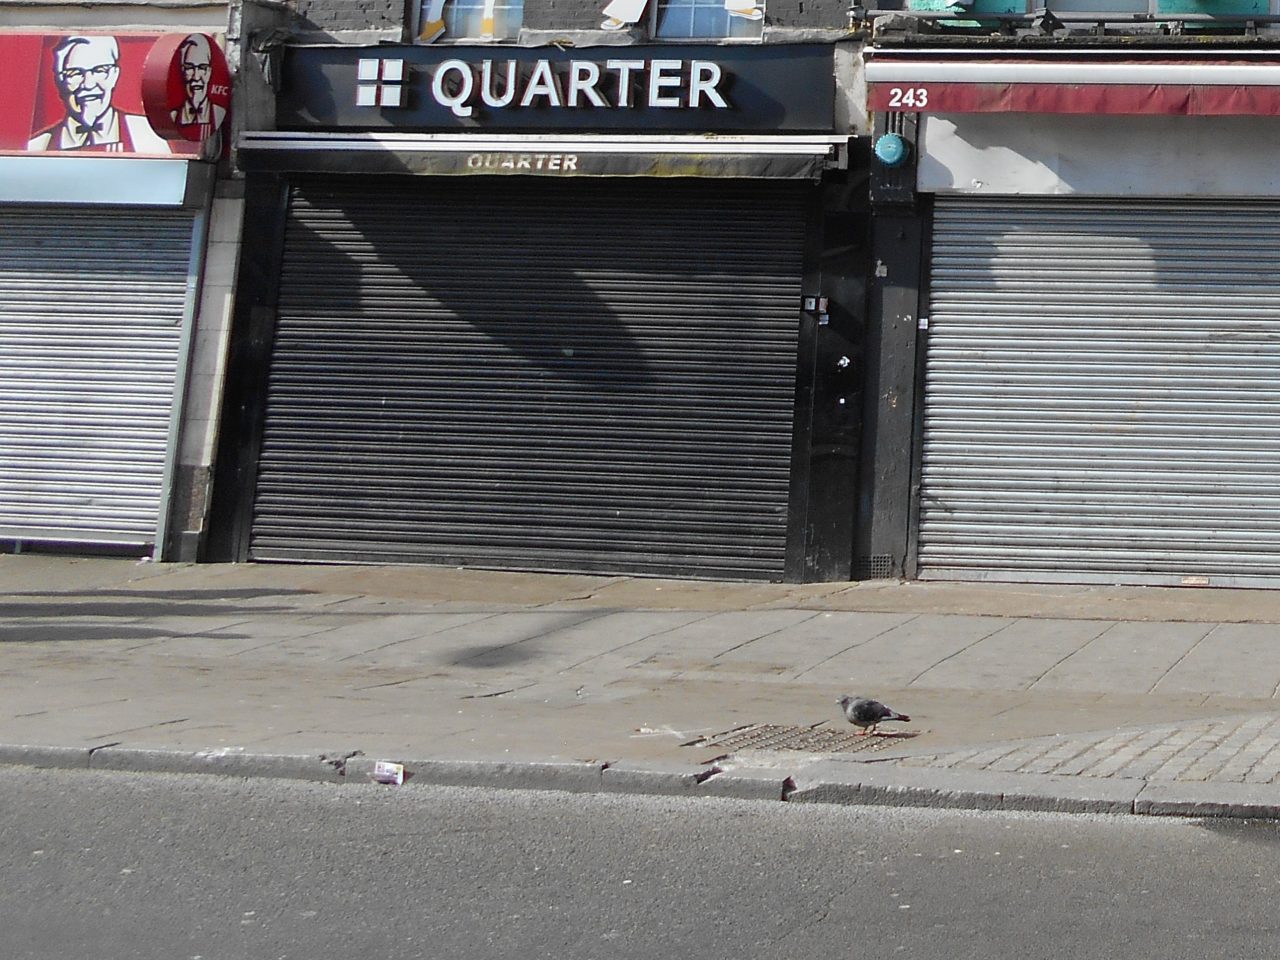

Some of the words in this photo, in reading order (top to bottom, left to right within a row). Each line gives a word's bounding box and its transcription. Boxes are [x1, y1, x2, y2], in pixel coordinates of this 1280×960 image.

[210, 84, 229, 96] KFC
[431, 58, 729, 117] QUARTER
[888, 87, 929, 108] 243
[467, 153, 578, 170] QUARTER
